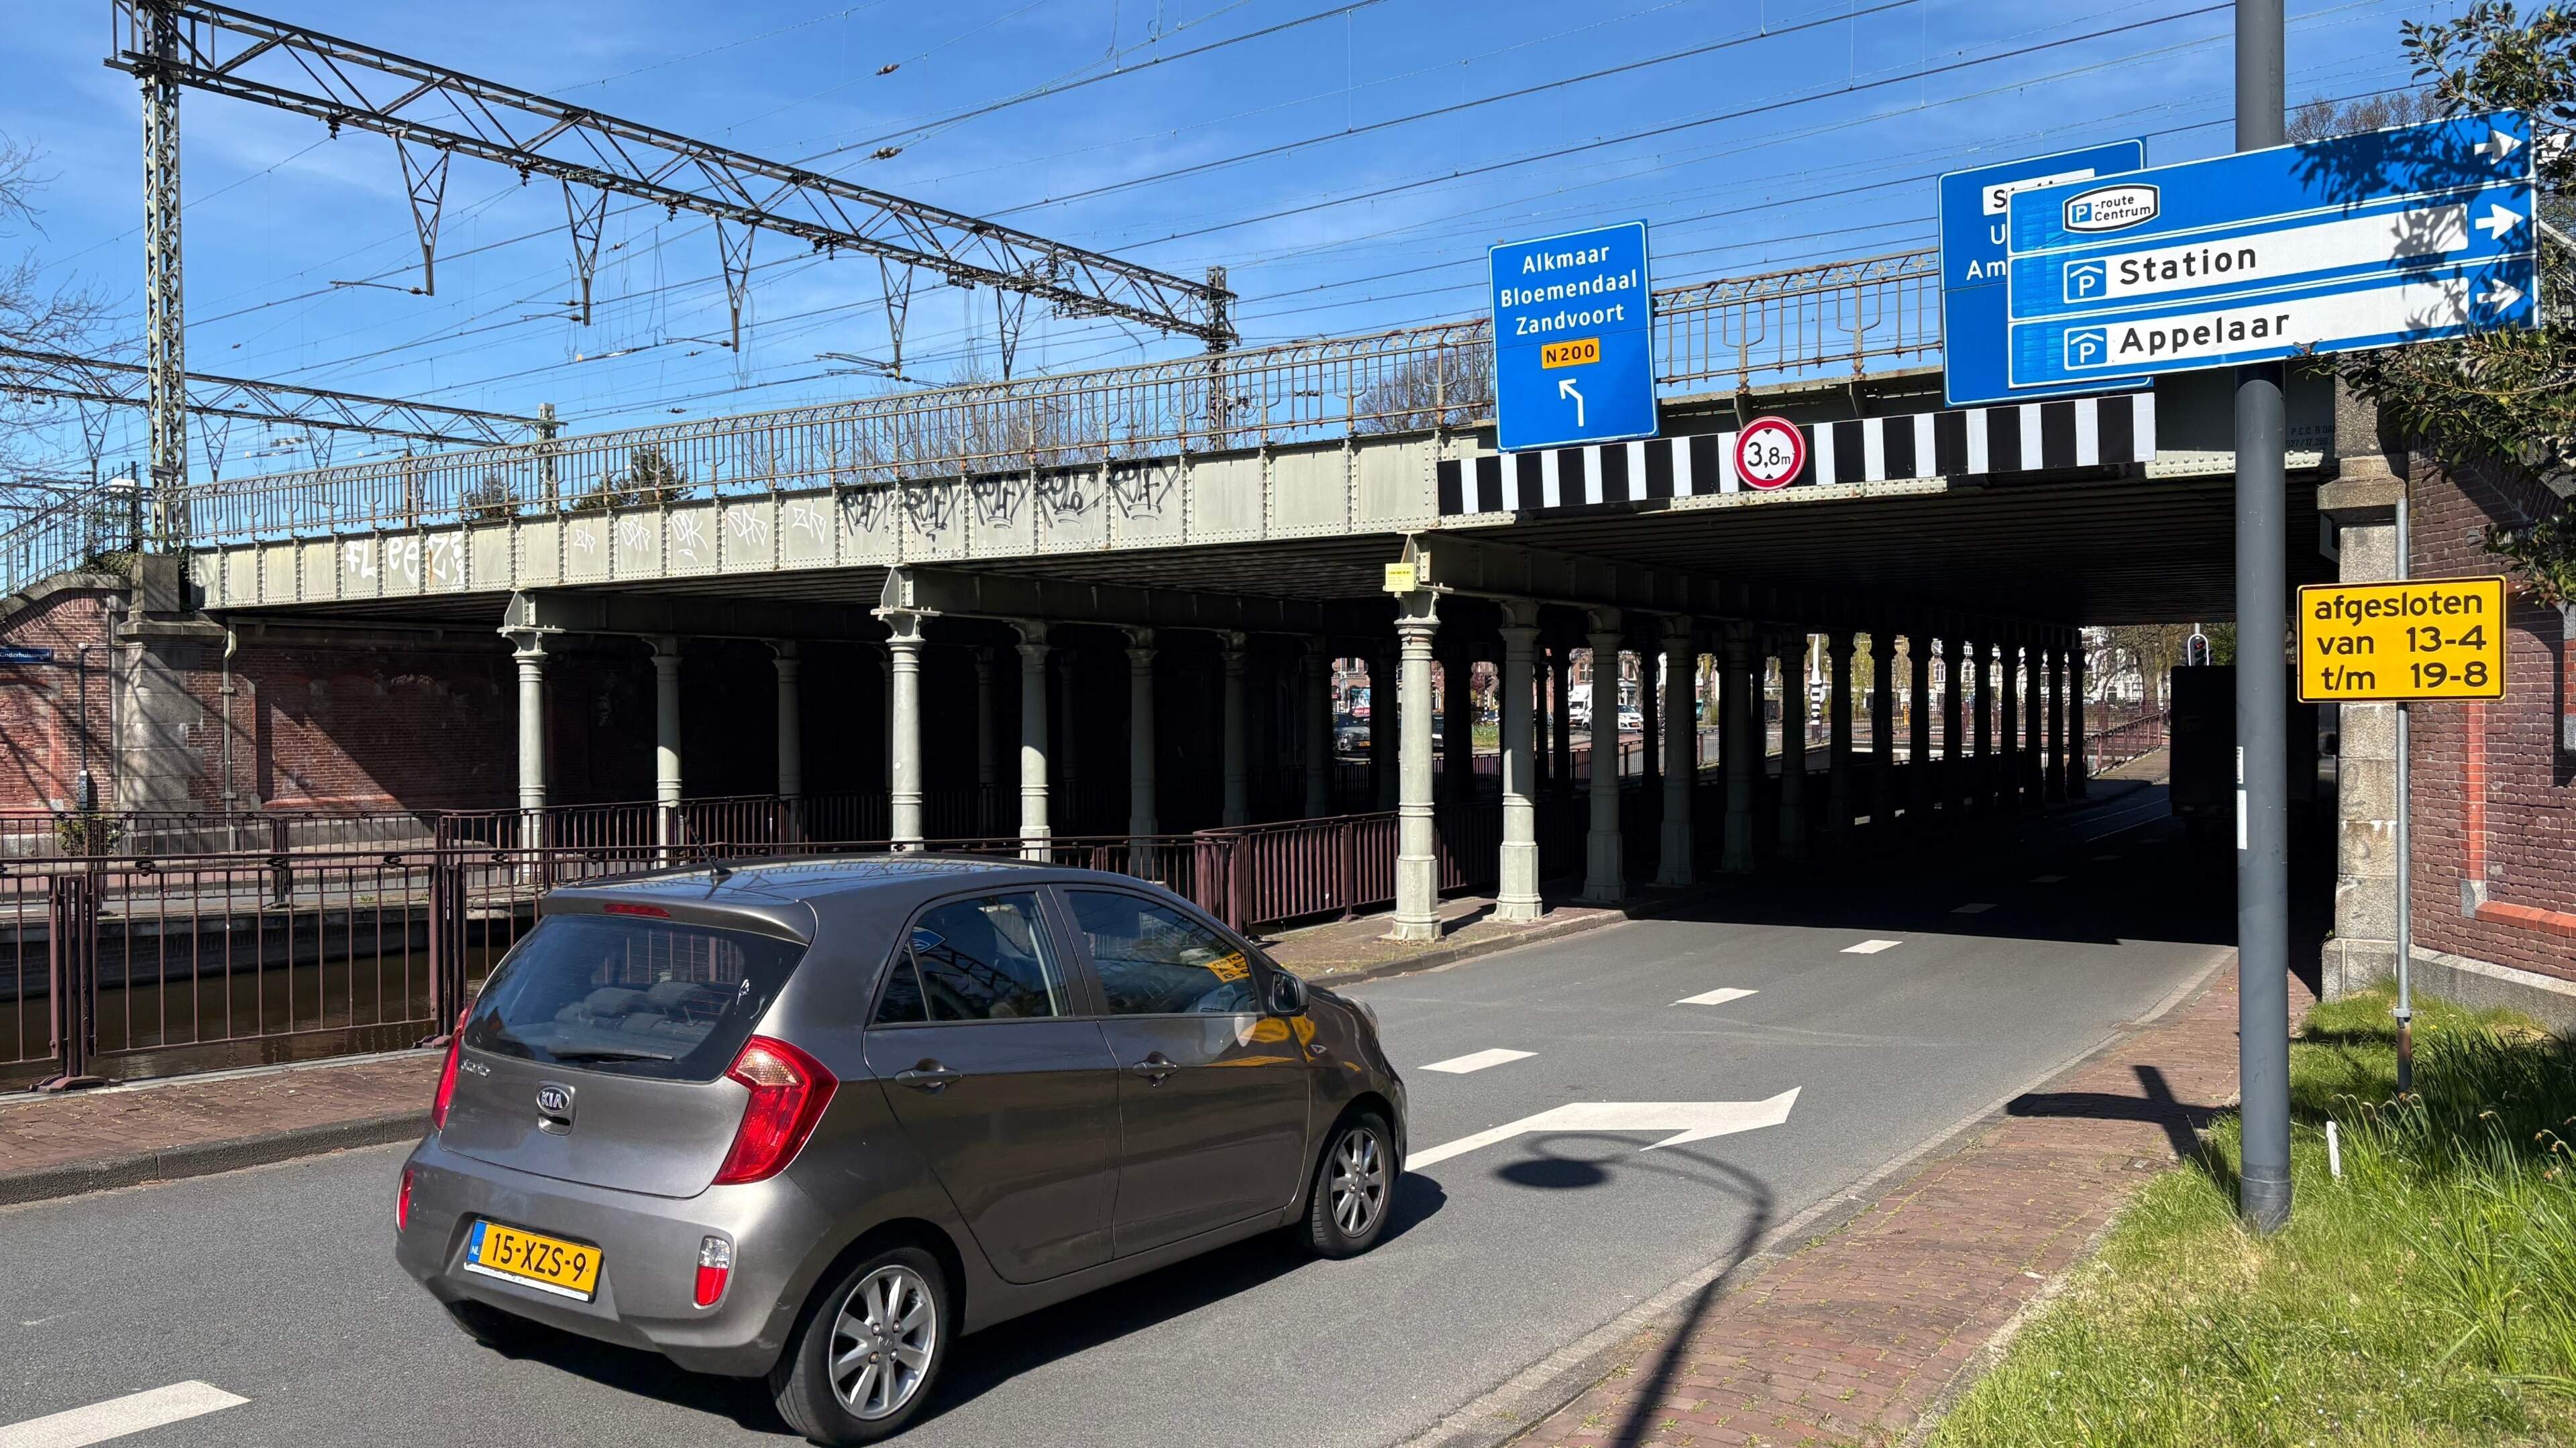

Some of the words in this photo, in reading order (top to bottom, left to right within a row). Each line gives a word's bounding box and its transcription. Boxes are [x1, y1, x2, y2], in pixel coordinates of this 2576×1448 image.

[2094, 195, 2135, 209] -route
[2094, 205, 2151, 221] Centrum
[1522, 245, 1610, 274] Alkmaar
[2119, 248, 2256, 285] Station
[1500, 268, 1638, 308] Bloemendaal
[1515, 303, 1625, 335] Zandvoort
[2119, 314, 2290, 356] Appelaar
[1546, 344, 1595, 363] N200
[2314, 591, 2482, 626] afgesloten
[2316, 634, 2374, 655] van
[2406, 624, 2487, 653] 13-4
[2321, 665, 2375, 691] t/m
[2410, 661, 2489, 688] 19-8
[541, 1091, 563, 1109] KIA
[471, 1245, 480, 1256] NL
[492, 1232, 587, 1282] 15-XZS-9
